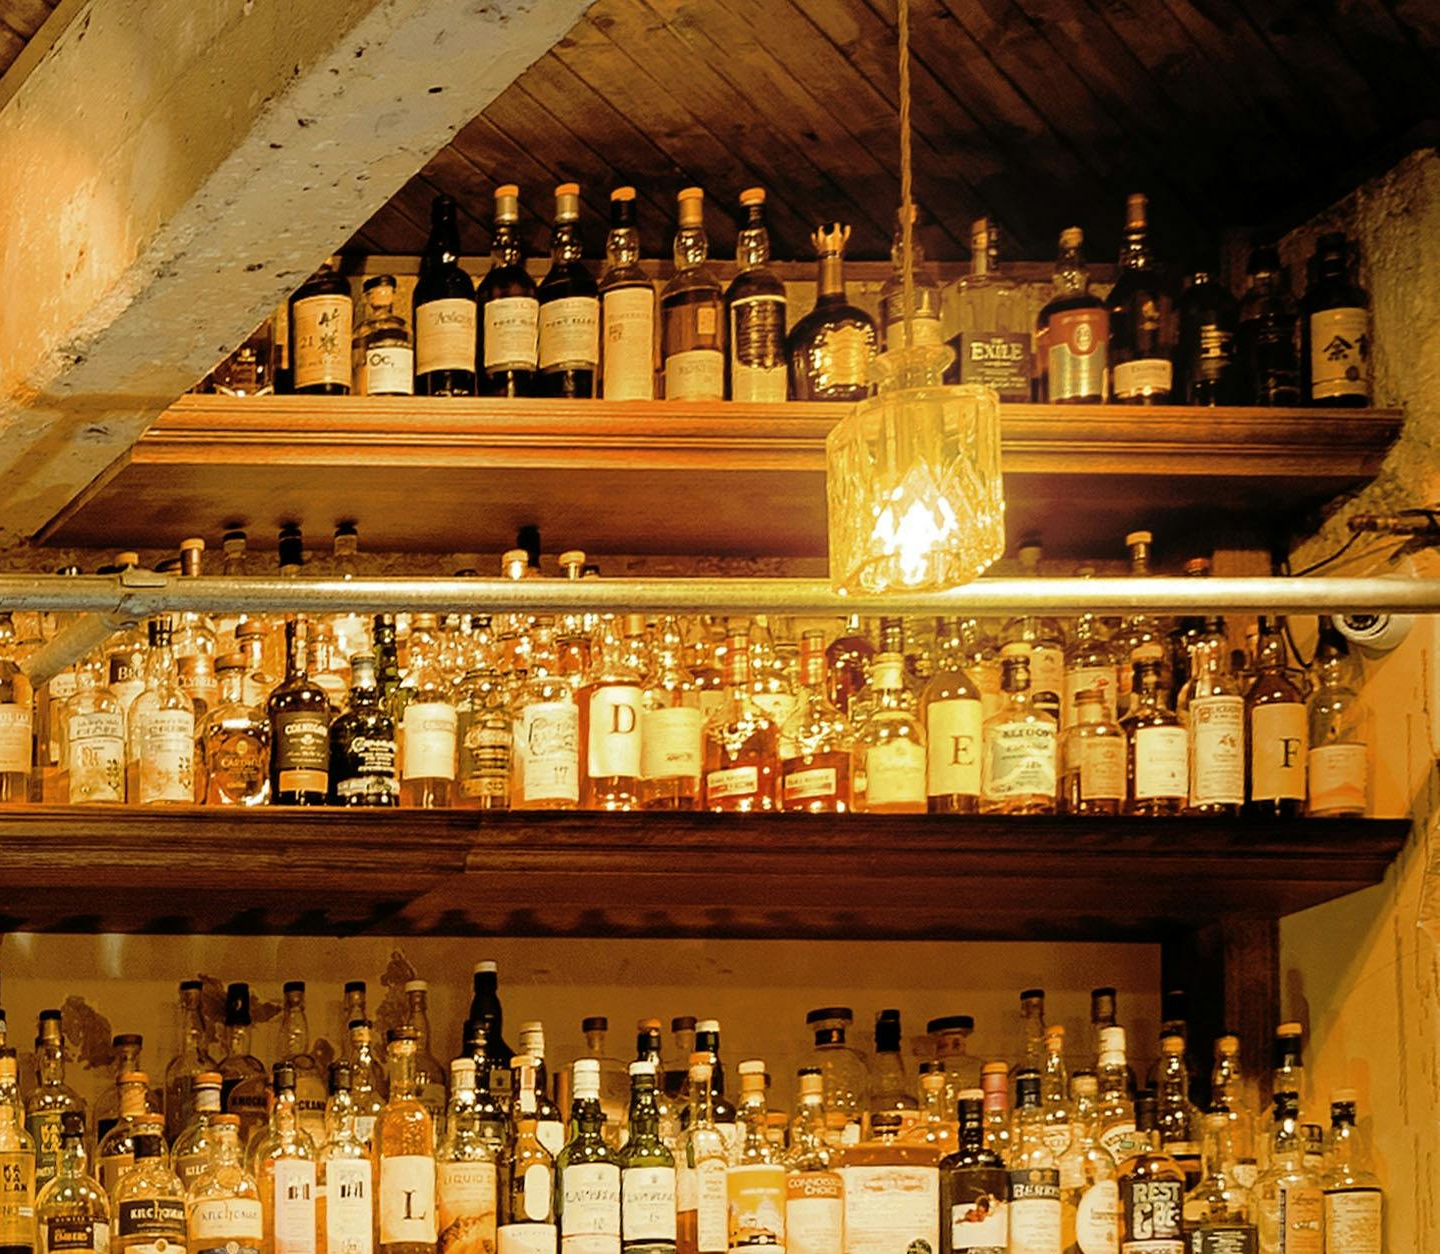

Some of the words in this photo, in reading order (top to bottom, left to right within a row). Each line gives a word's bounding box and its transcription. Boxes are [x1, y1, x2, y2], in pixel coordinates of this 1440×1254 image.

[970, 342, 1024, 361] EXILE
[610, 703, 637, 735] D
[948, 735, 975, 766] E
[1278, 736, 1302, 769] F
[3, 1163, 21, 1174] KA
[4, 1174, 21, 1183] VA
[3, 1182, 28, 1192] LAN
[1132, 1181, 1182, 1203] REST
[402, 1190, 427, 1220] L
